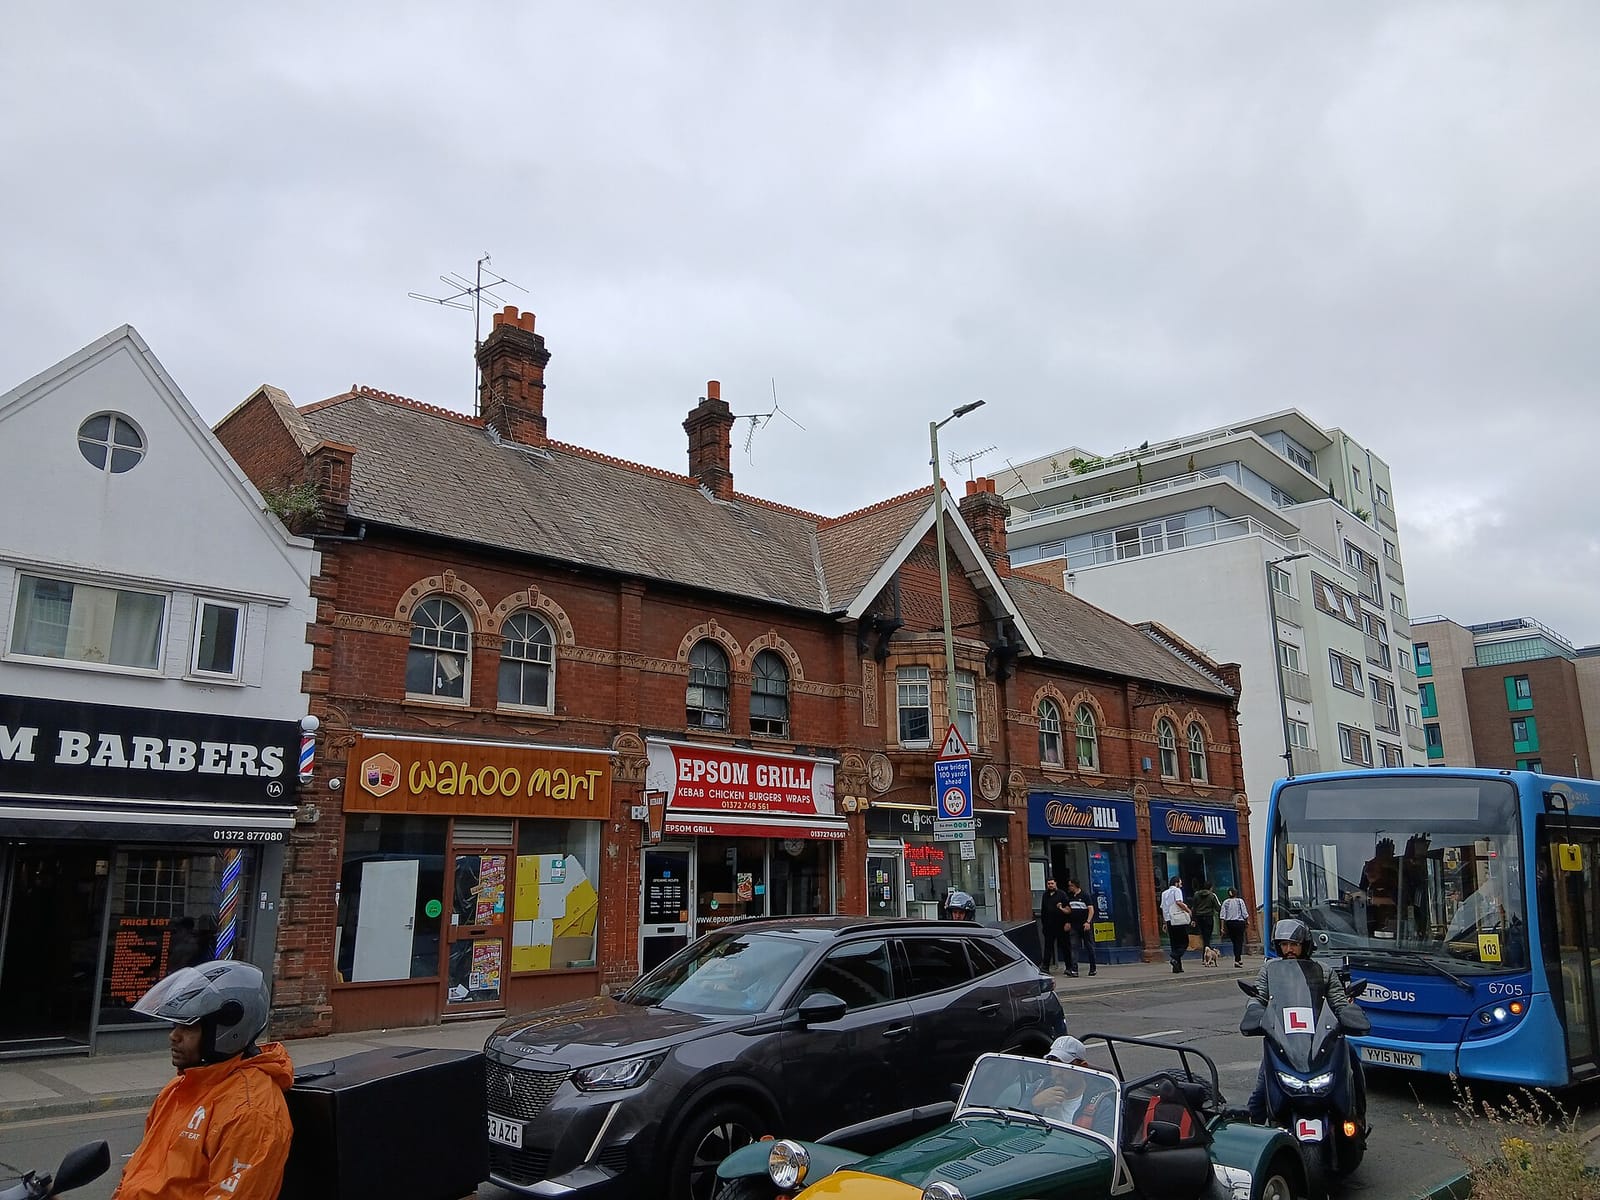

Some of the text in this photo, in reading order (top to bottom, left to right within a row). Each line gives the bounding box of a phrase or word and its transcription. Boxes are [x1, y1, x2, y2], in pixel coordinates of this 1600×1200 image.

[54, 730, 285, 778] BARBERS
[678, 758, 811, 789] EPSOM GRILL
[937, 763, 968, 772] Low bridge
[950, 770, 967, 779] yards
[944, 777, 962, 785] ahead
[678, 787, 811, 804] KEBAB CHICKEN BURGERS WRAPS
[721, 801, 742, 809] 01372
[1045, 801, 1120, 830] William HILL
[1165, 810, 1227, 835] William HILL
[213, 830, 283, 841] 01372 877080
[665, 824, 715, 833] EPSOM GRILL
[120, 918, 171, 926] PRICE LIST
[1483, 944, 1497, 955] 103
[1488, 982, 1523, 996] 6705
[1289, 1011, 1307, 1029] L
[1366, 1048, 1416, 1066] YY15 NHX
[498, 1122, 518, 1144] AZG
[1299, 1121, 1316, 1137] L
